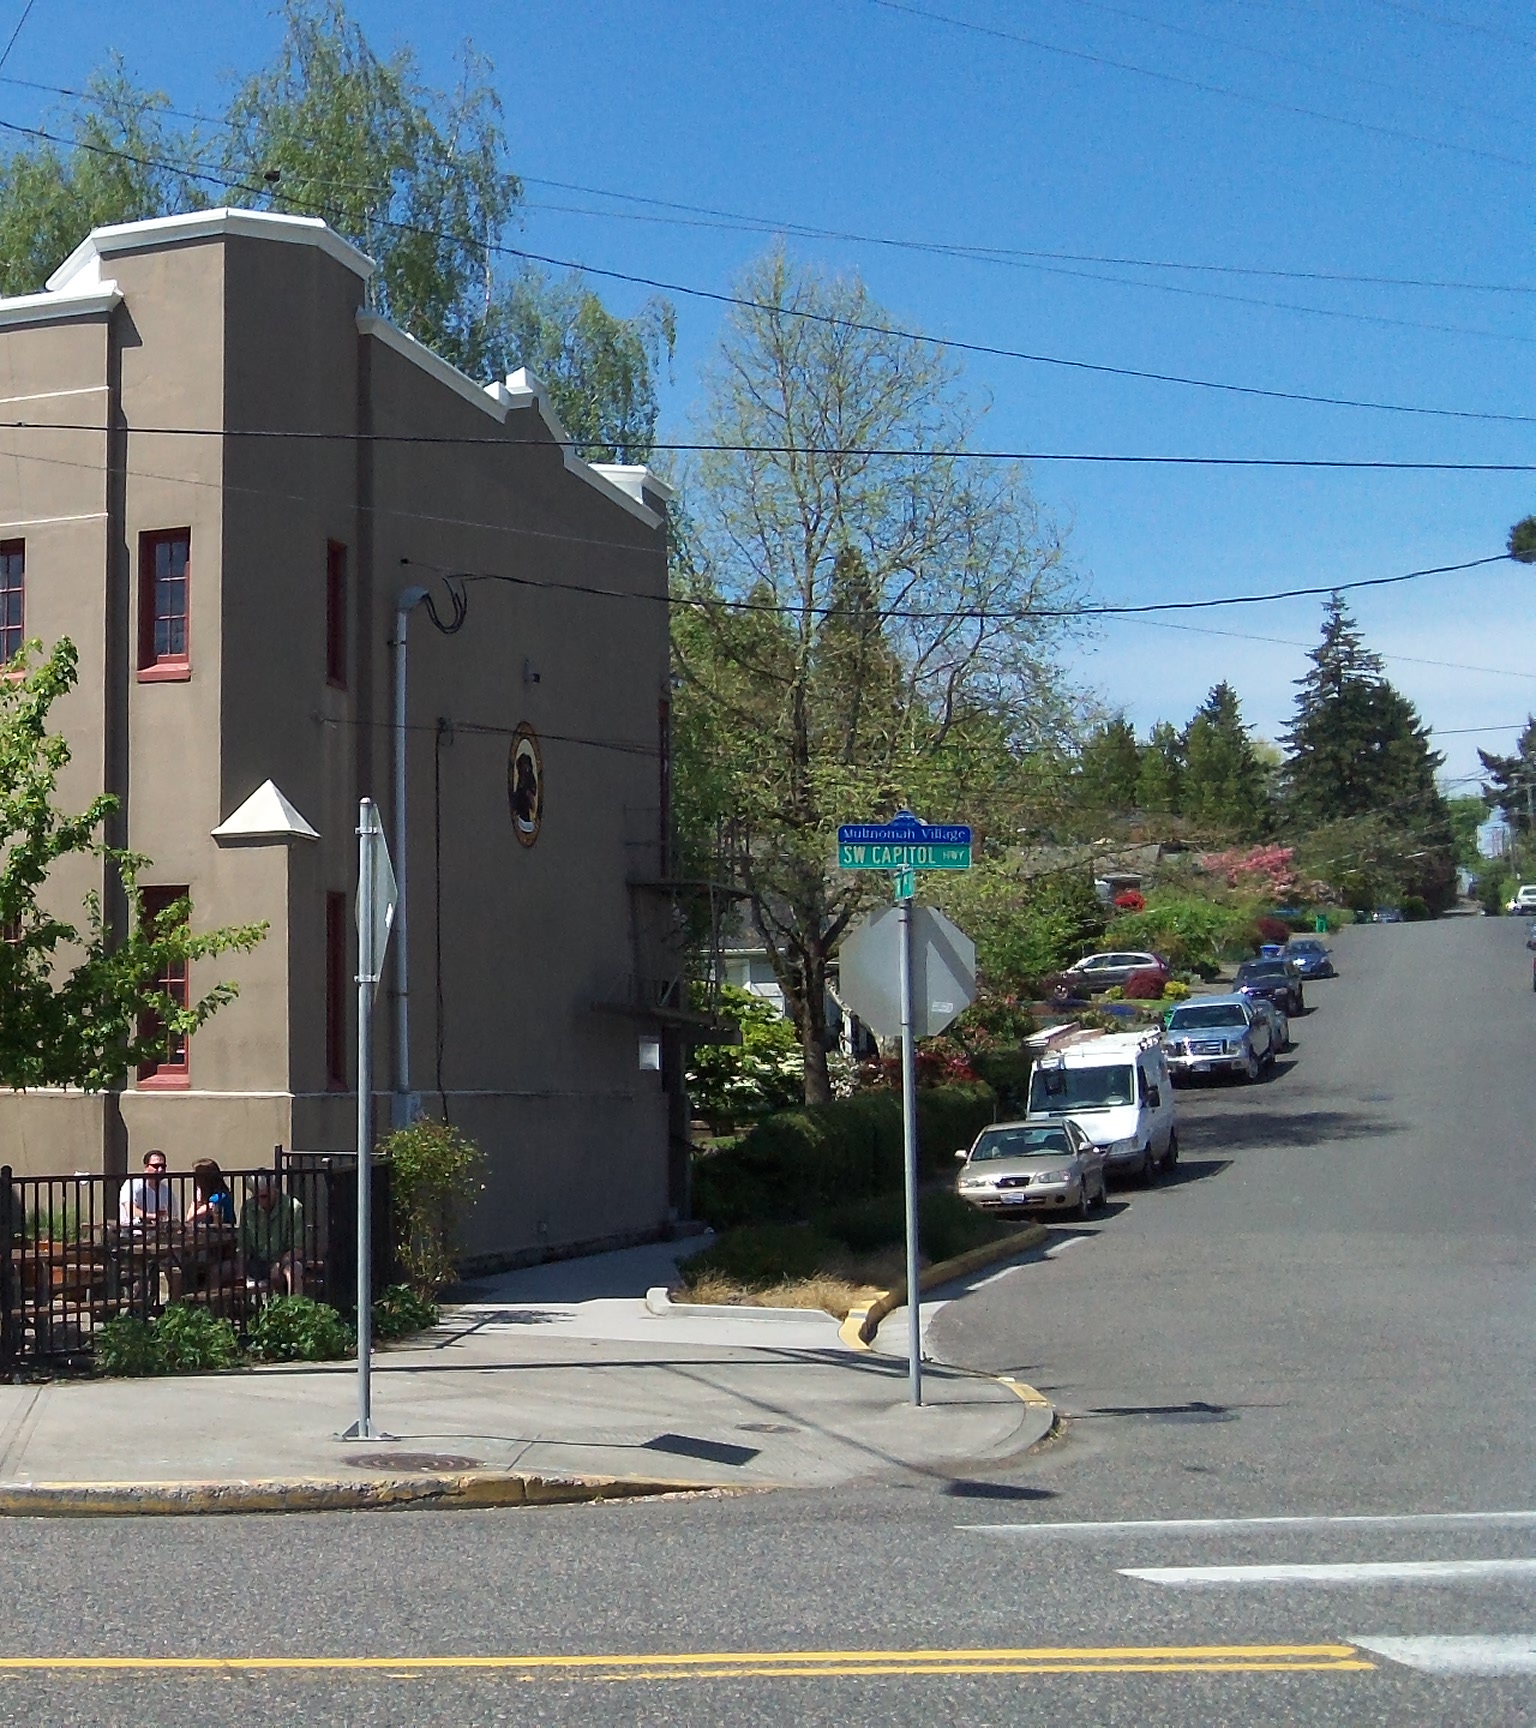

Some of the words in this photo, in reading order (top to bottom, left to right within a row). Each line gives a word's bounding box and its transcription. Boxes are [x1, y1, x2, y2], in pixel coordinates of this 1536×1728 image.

[921, 828, 965, 841] Village
[843, 846, 865, 864] SW
[872, 846, 936, 864] CAPITOL
[942, 851, 965, 860] HWY
